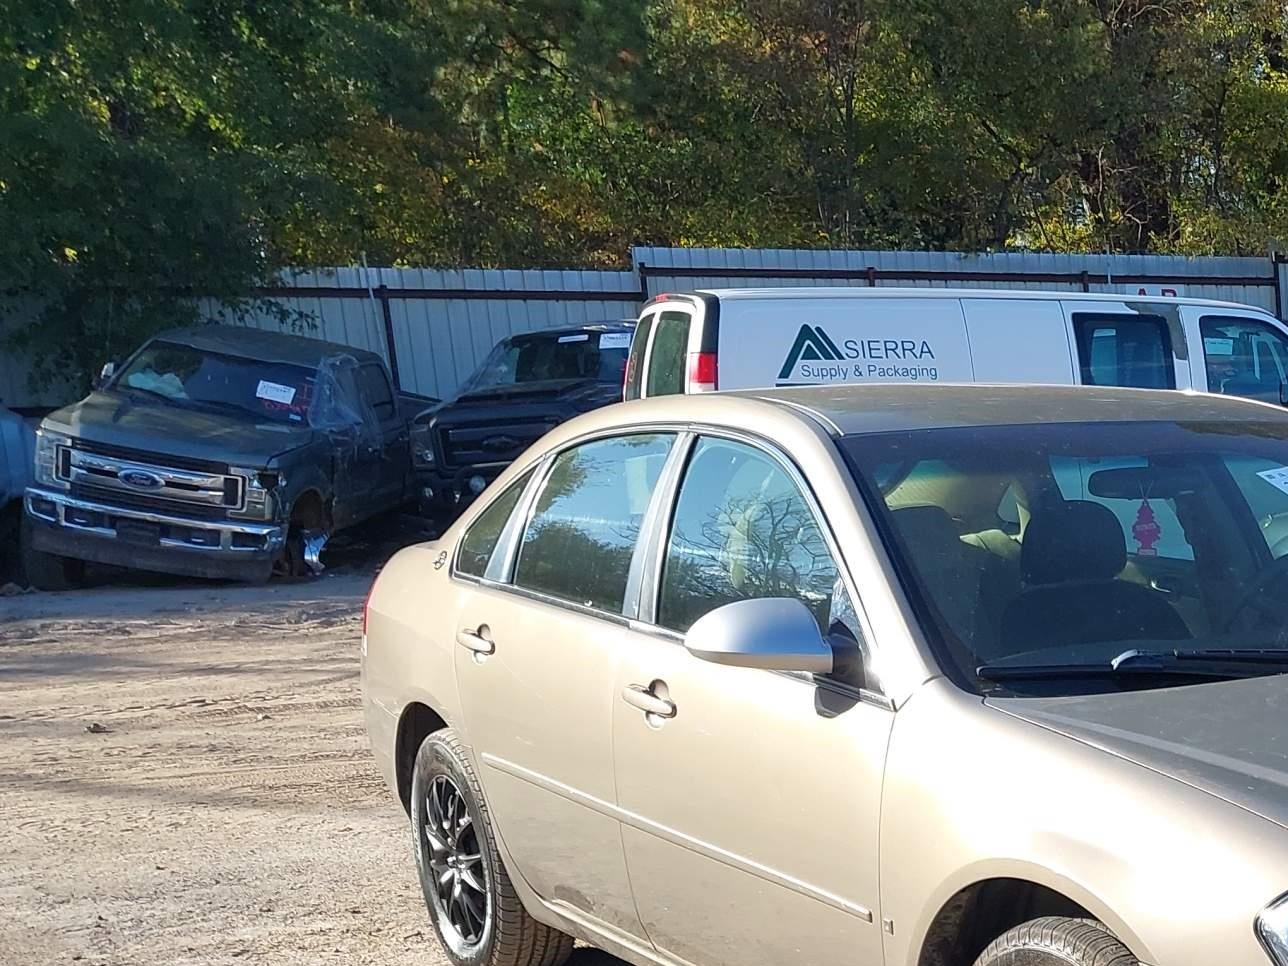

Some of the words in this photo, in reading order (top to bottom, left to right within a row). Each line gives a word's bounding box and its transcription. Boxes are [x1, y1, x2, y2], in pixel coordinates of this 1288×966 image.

[844, 340, 935, 359] SIERRA
[801, 364, 848, 380] Supply
[853, 365, 863, 377] &
[868, 365, 938, 380] Packaging
